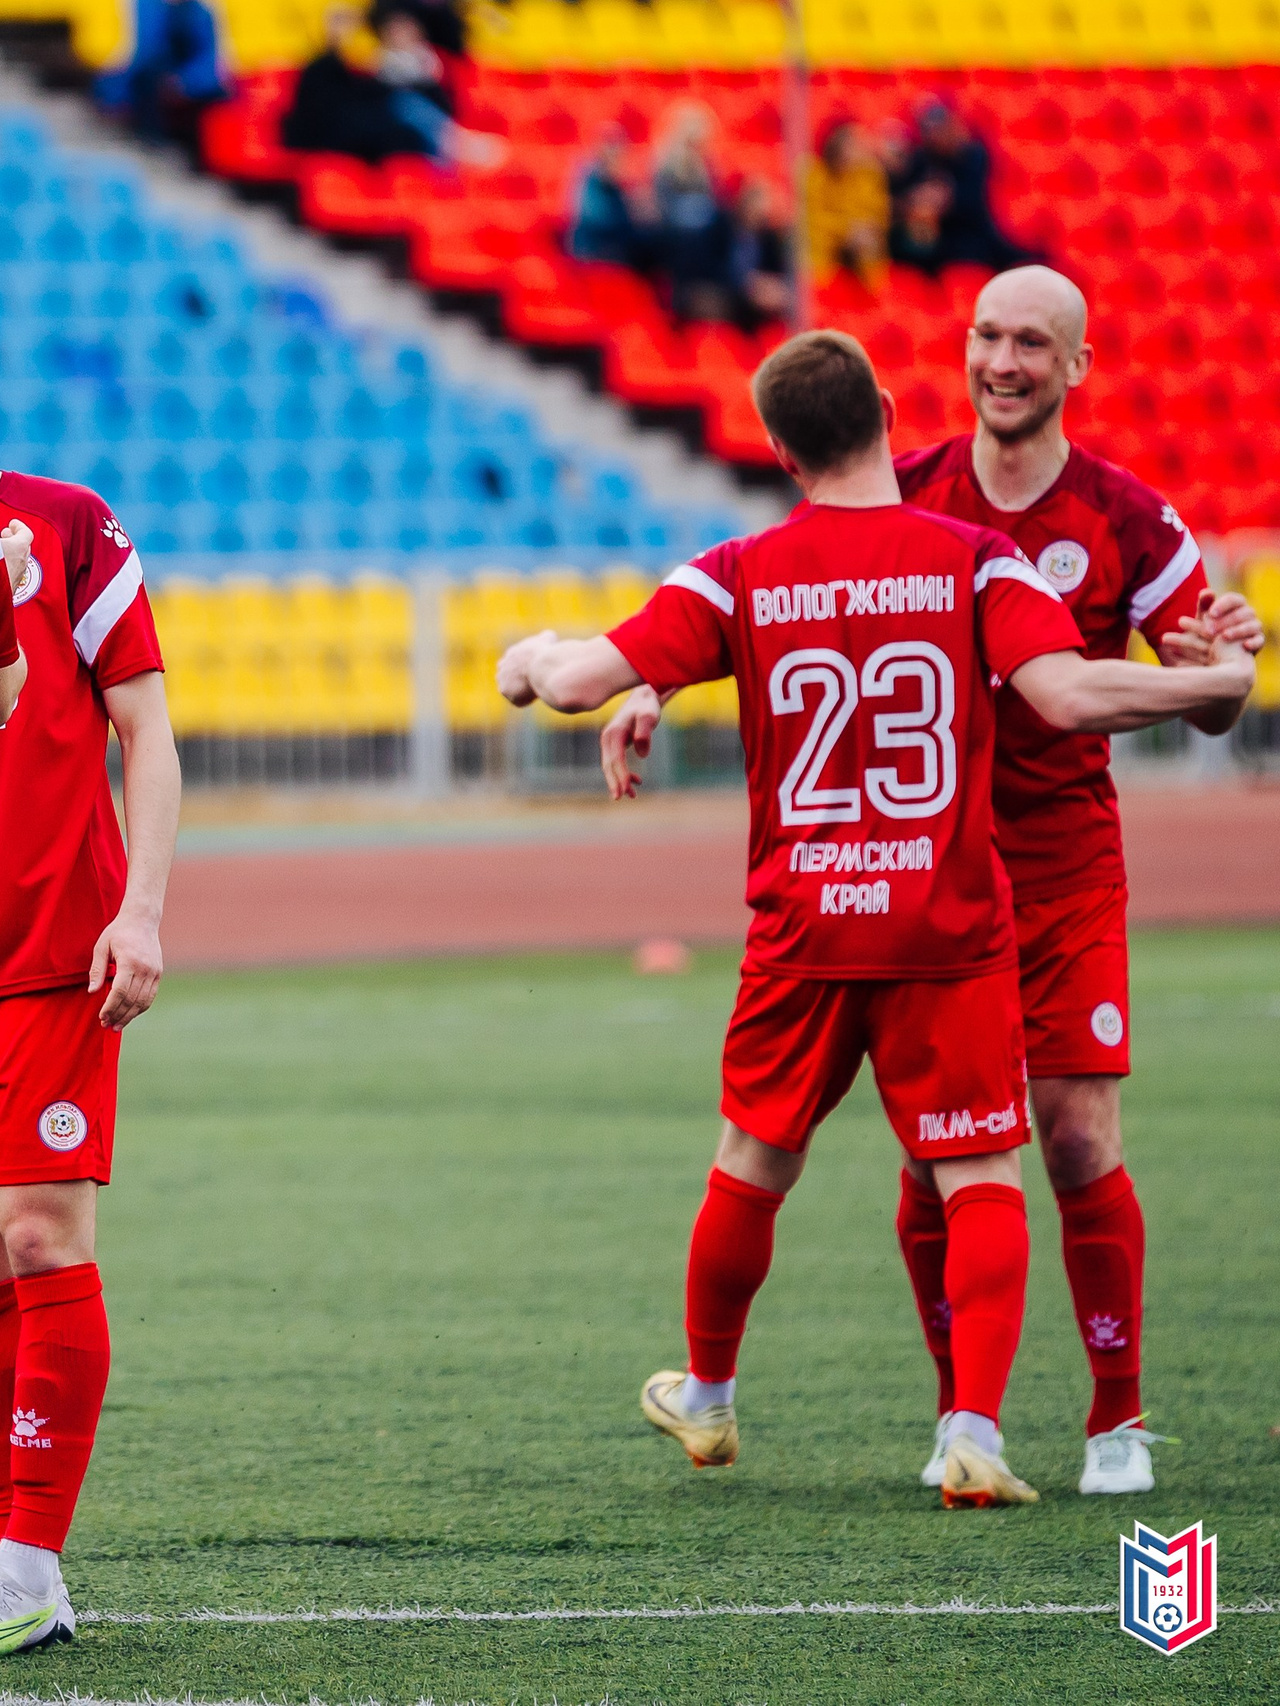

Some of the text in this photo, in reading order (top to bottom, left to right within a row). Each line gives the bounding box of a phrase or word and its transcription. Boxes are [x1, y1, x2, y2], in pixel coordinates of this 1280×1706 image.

[752, 574, 955, 627] ВОЛОГЖАНИН
[769, 641, 957, 826] 23
[789, 836, 933, 874] ПЕРМСКИЙ
[820, 879, 890, 915] КРАЙ
